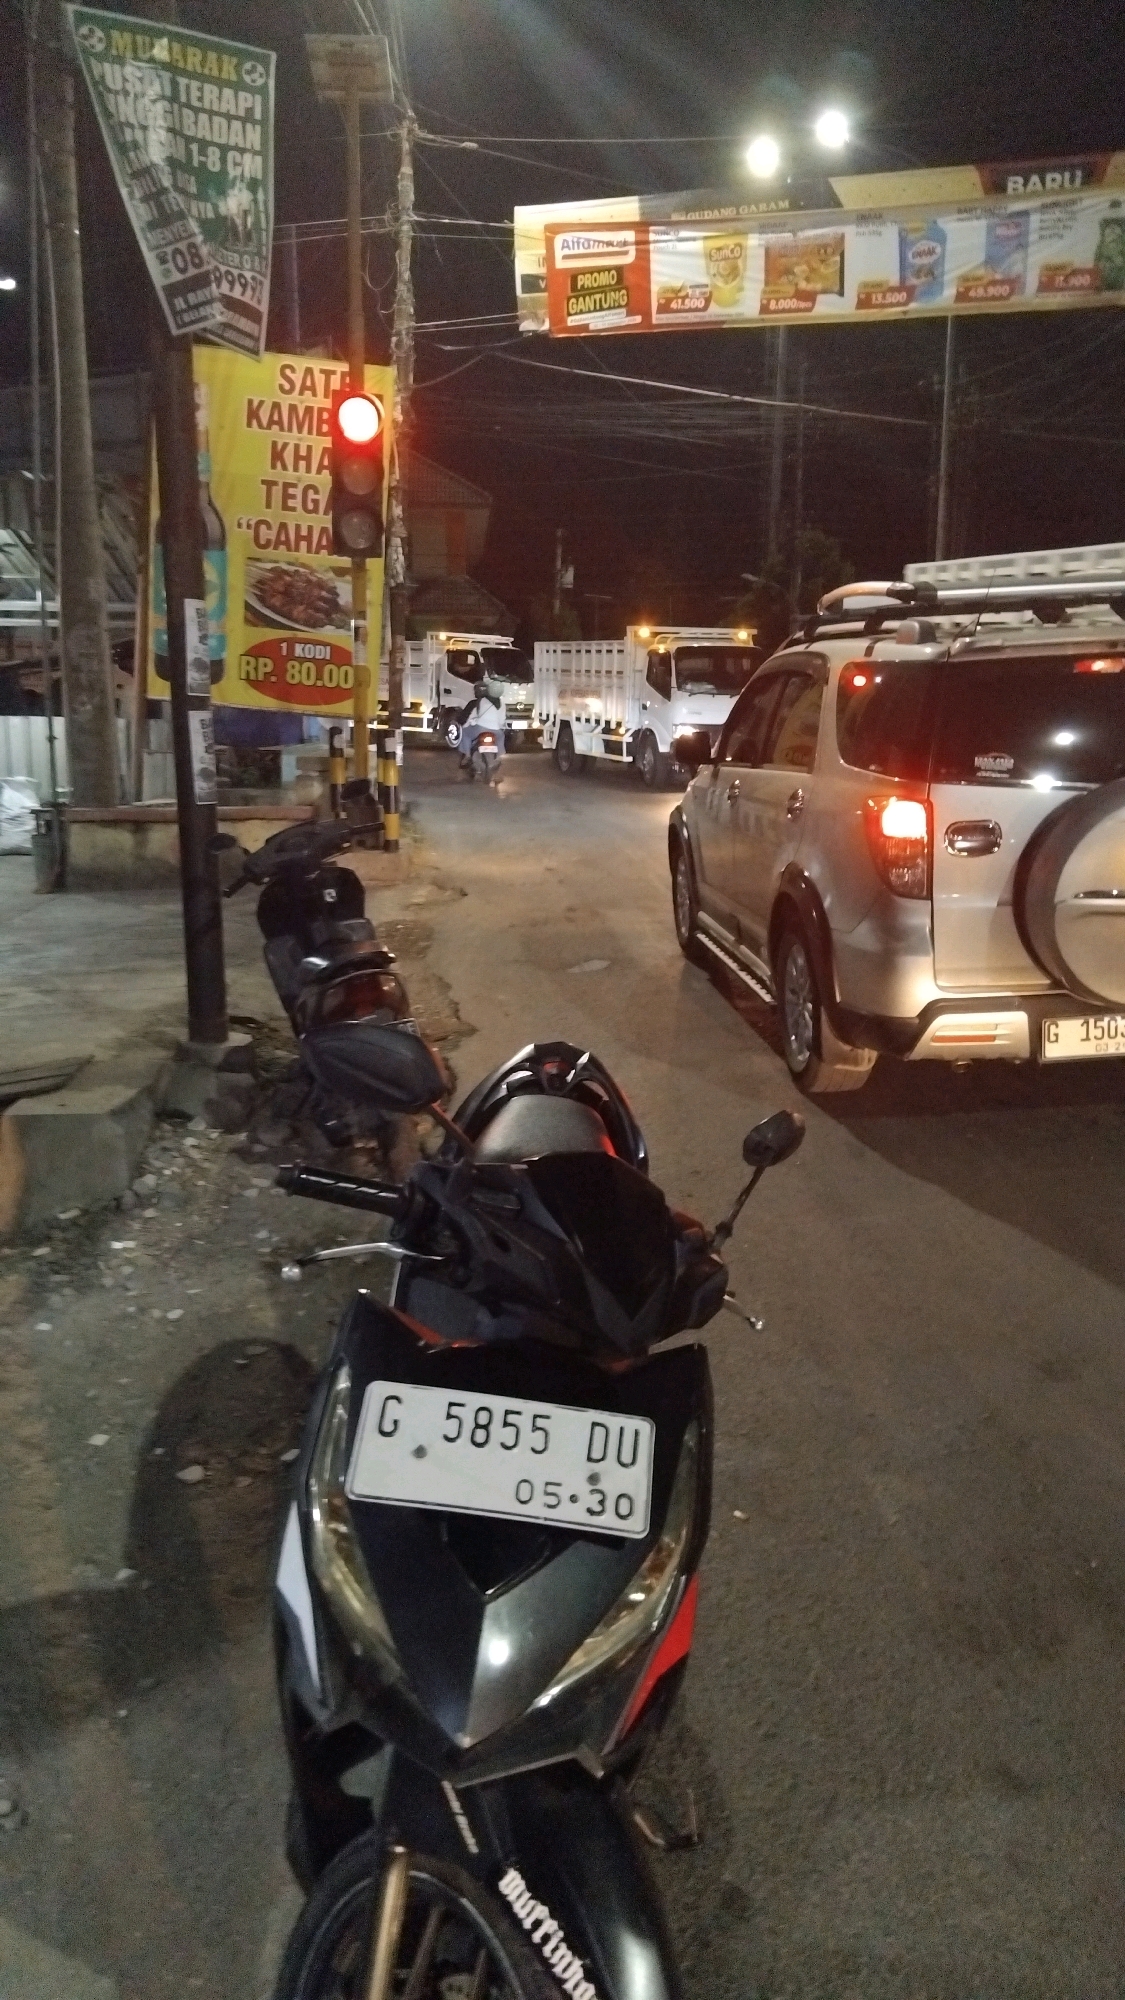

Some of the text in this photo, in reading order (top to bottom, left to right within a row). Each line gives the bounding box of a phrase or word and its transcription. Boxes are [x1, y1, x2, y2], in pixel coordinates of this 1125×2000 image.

[110, 29, 237, 82] MUARAK
[175, 76, 262, 120] TERAPI
[182, 106, 262, 151] BADAN
[189, 142, 221, 173] 1-8
[227, 150, 263, 180] CM
[1007, 170, 1082, 195] BARU
[687, 207, 737, 220] GUDANG
[739, 200, 790, 214] GARAM
[710, 245, 741, 260] SunCo
[577, 270, 617, 289] PROMO
[568, 289, 628, 315] GANTUNG
[670, 297, 706, 310] 41.500
[246, 397, 333, 438] KAMB
[270, 440, 333, 477] KHA
[280, 642, 331, 660] 1 KODI
[240, 655, 278, 682] RP.
[286, 660, 355, 690] 80.00
[1047, 1021, 1059, 1043] G
[377, 1394, 640, 1469] G 5855 DU
